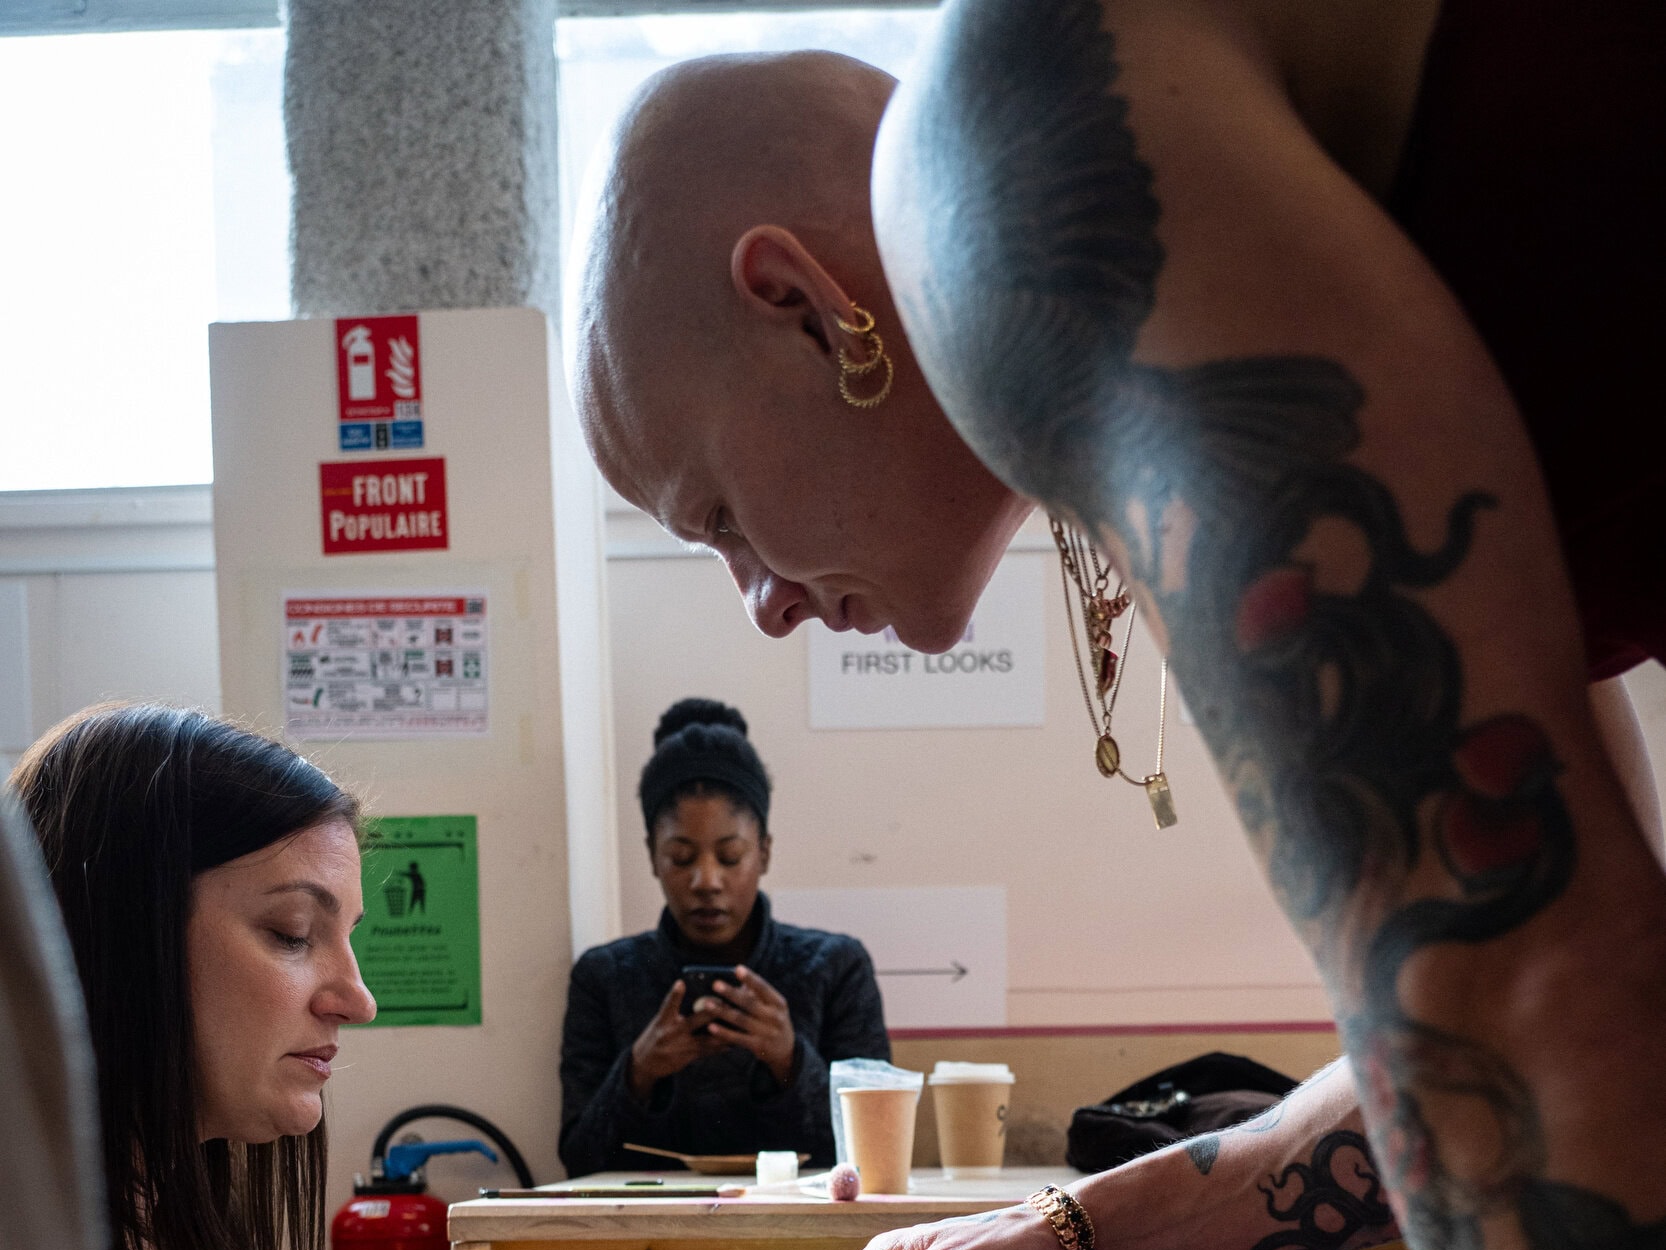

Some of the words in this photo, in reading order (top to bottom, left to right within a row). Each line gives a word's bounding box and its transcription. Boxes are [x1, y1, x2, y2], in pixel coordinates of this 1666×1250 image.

[352, 472, 429, 508] FRONT
[329, 509, 443, 542] POPULAIRE
[841, 652, 913, 675] FIRST
[923, 650, 1014, 674] LOOKS
